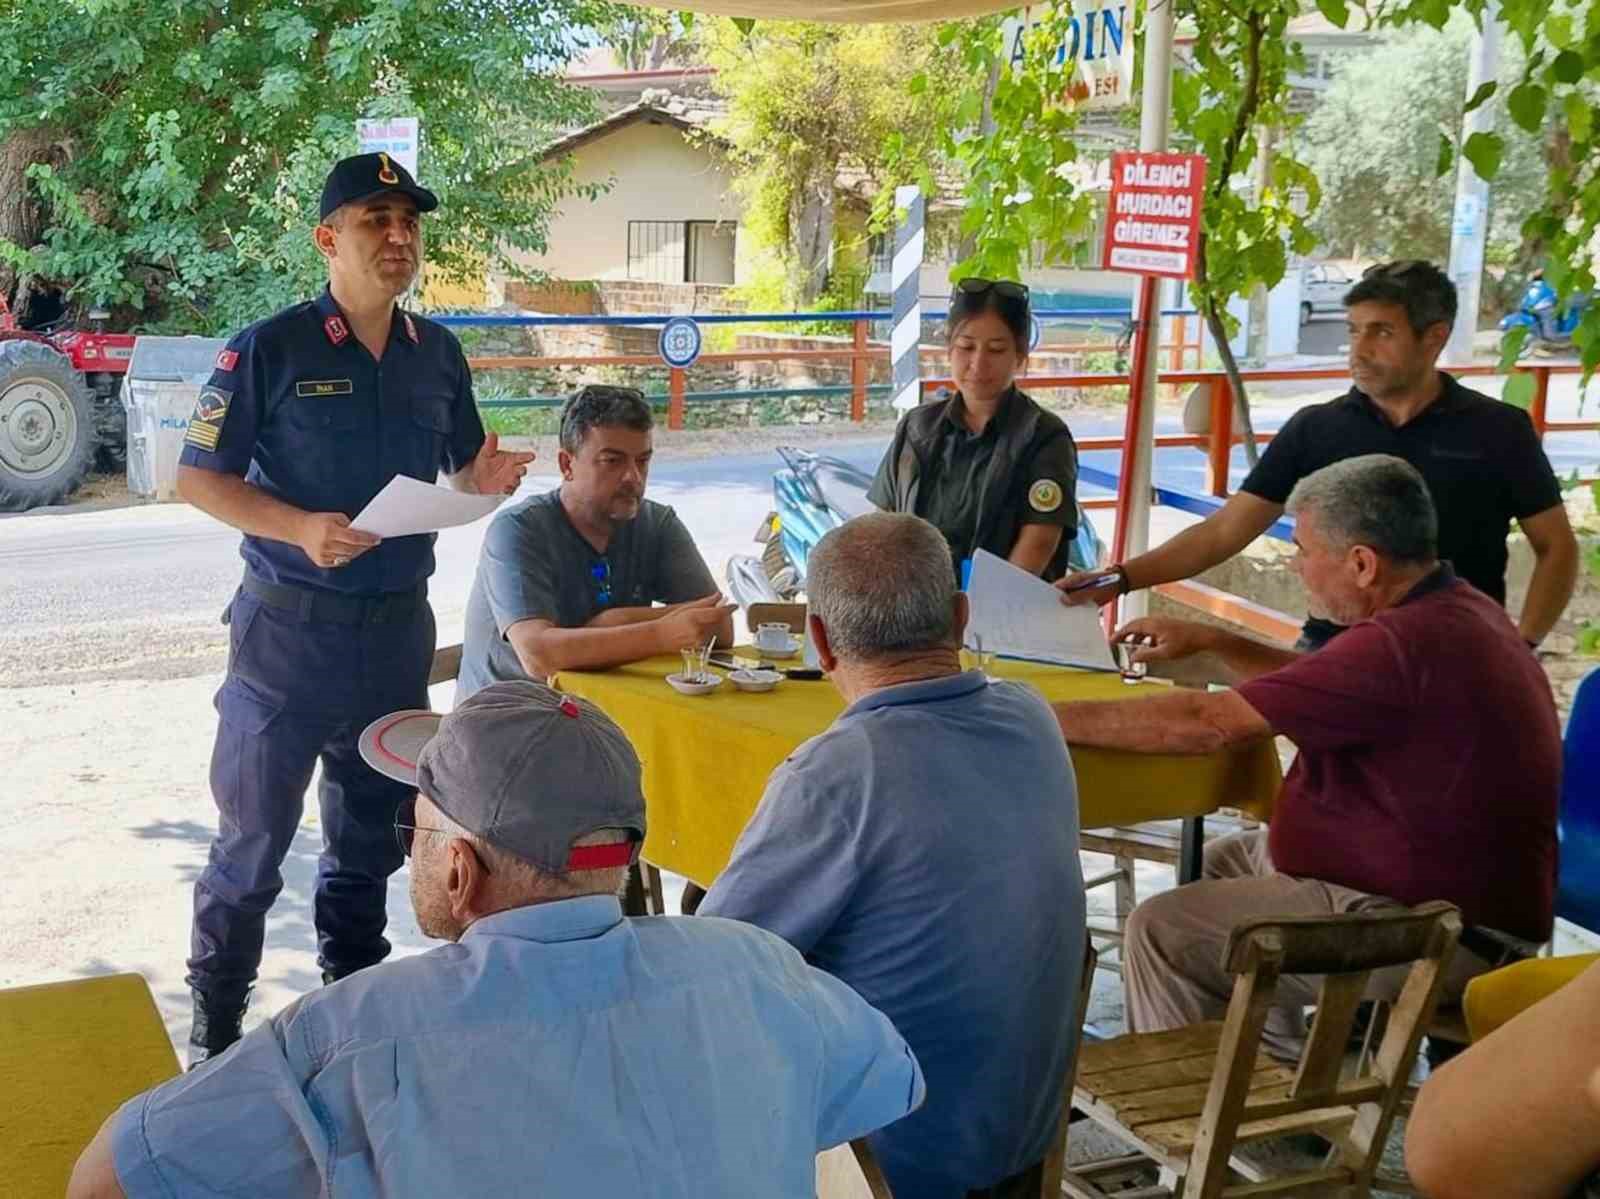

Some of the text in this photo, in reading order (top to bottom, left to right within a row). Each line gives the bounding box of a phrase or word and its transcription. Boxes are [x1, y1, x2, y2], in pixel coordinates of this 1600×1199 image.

[1009, 6, 1126, 71] ADIN
[1123, 159, 1192, 188] DİLENCİ
[1116, 192, 1193, 218] HURDACI
[1114, 216, 1190, 248] GİREMEZ
